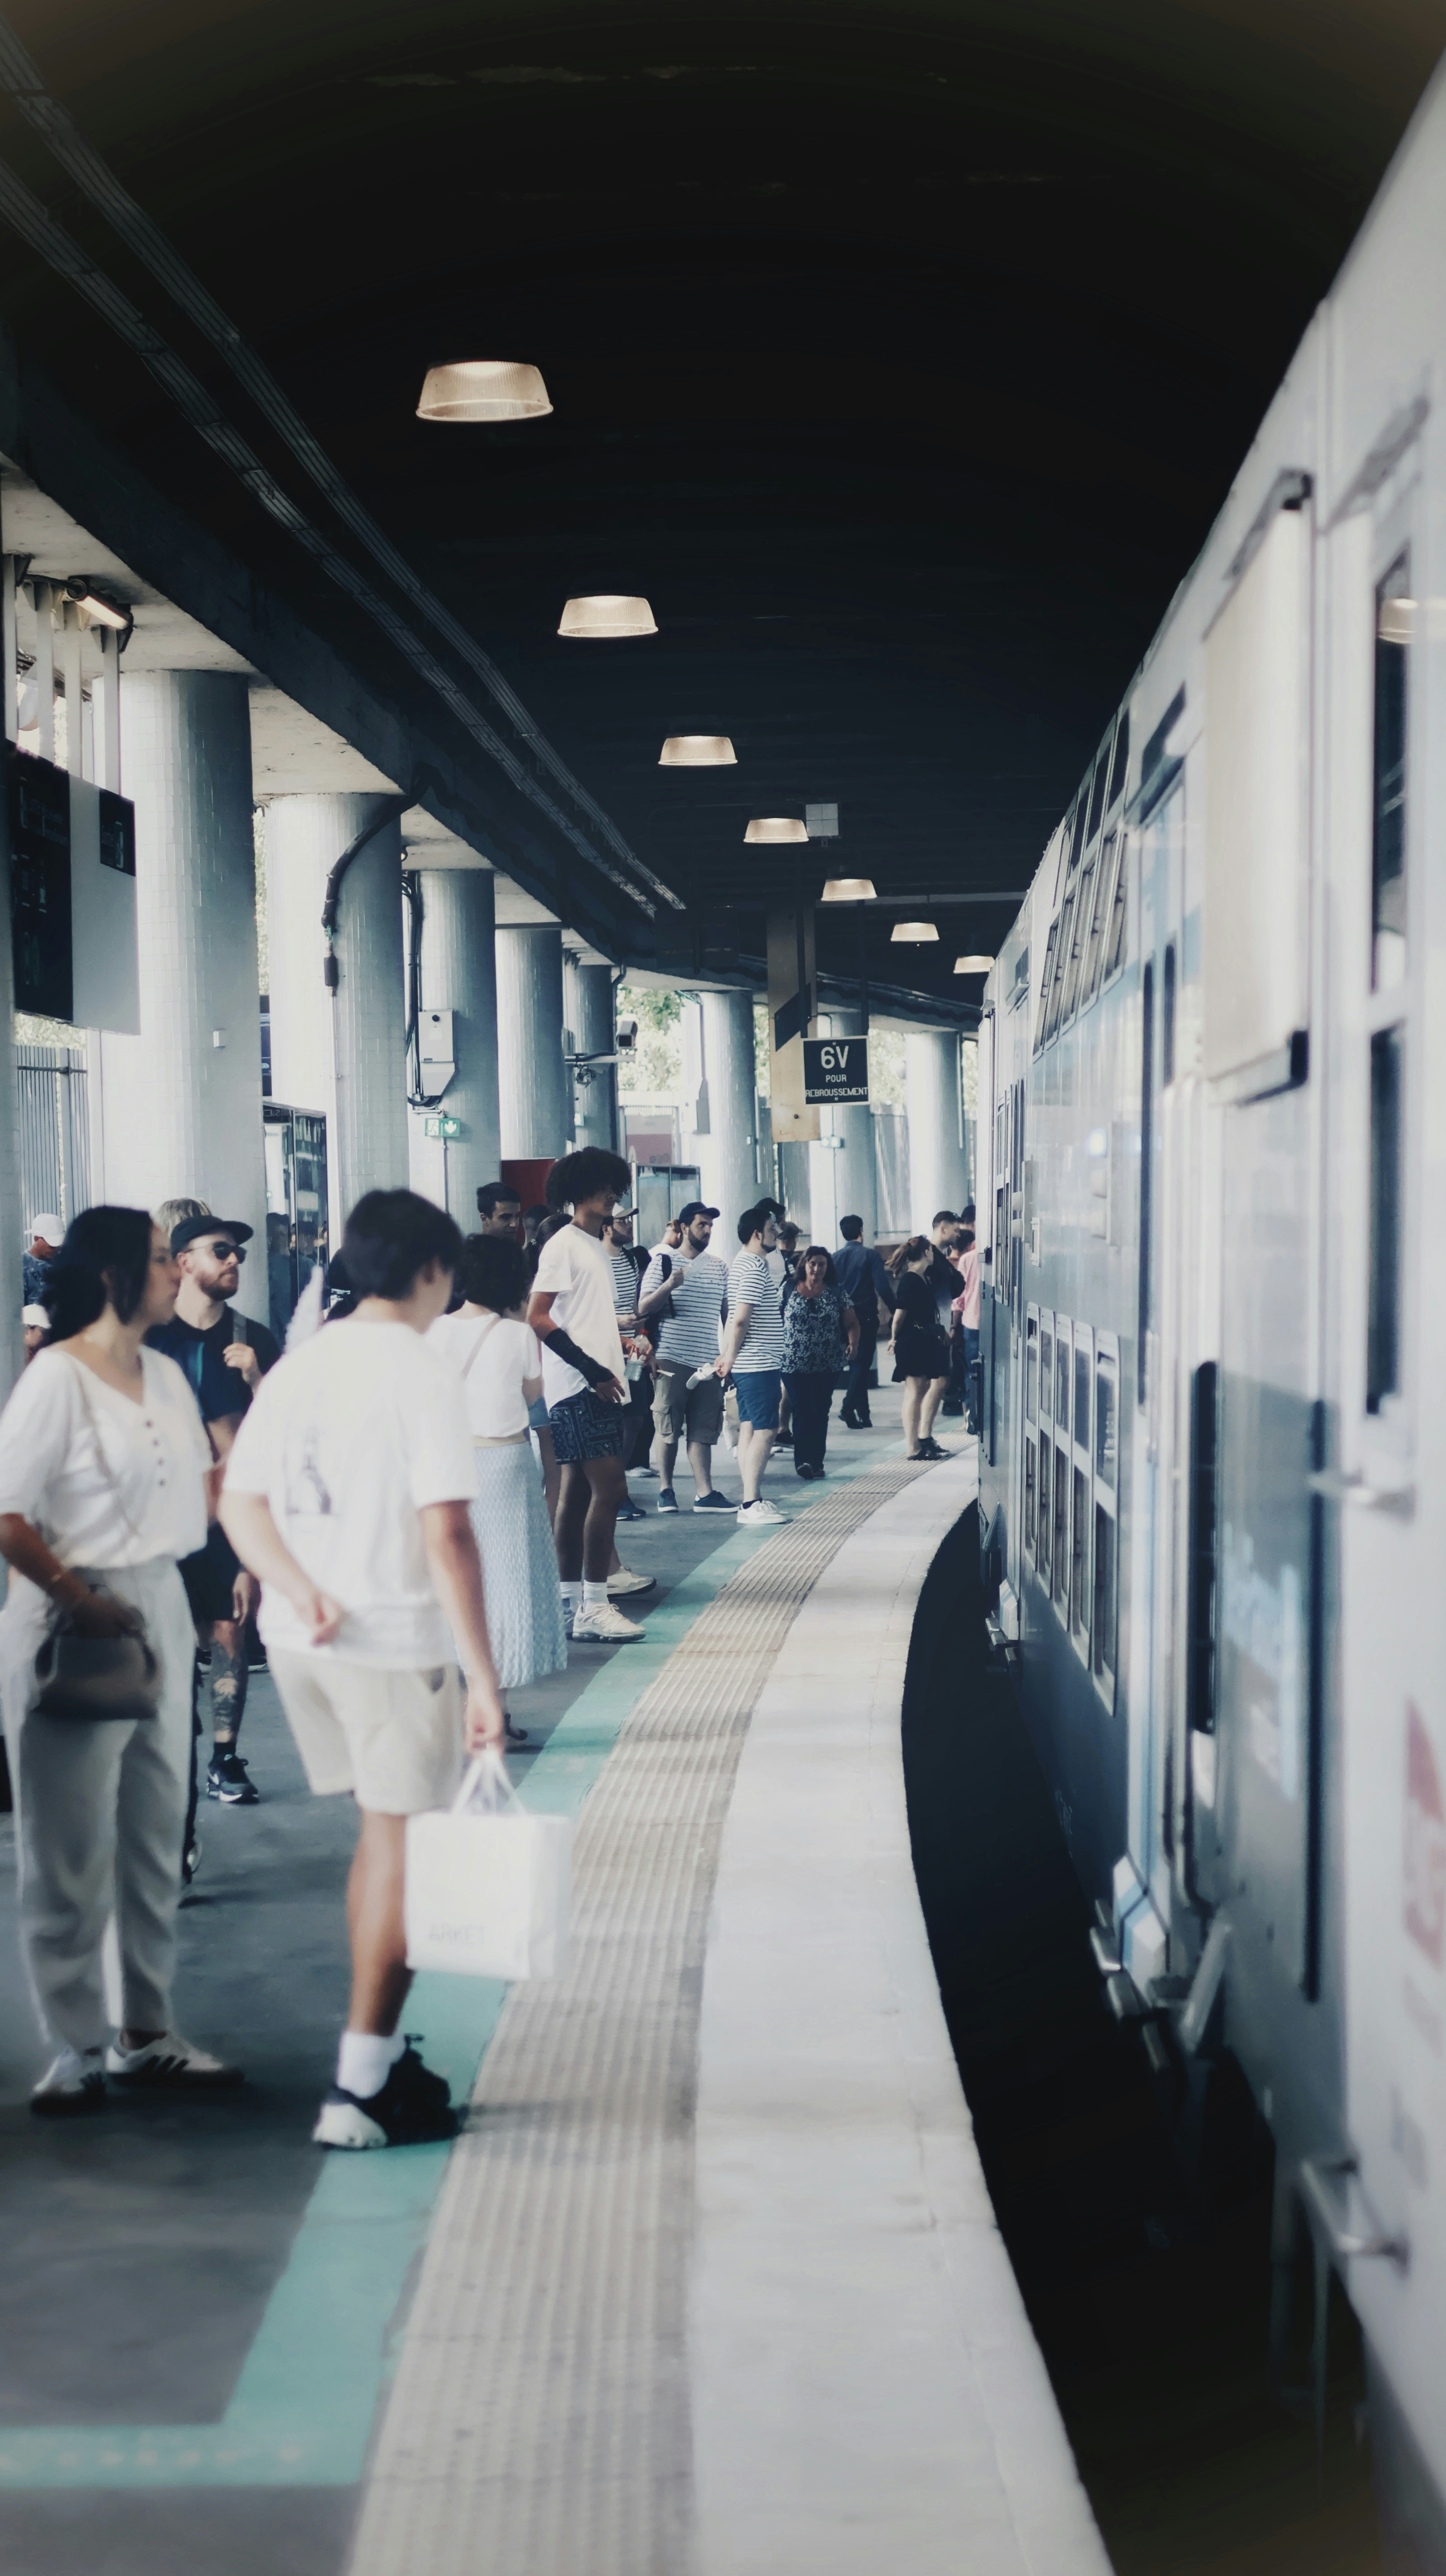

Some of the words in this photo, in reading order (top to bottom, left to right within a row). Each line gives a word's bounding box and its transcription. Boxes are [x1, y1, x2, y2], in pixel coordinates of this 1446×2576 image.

[821, 1045, 849, 1069] 6V
[826, 1074, 847, 1083] POUR
[805, 1087, 868, 1097] REBROUSSEMENT
